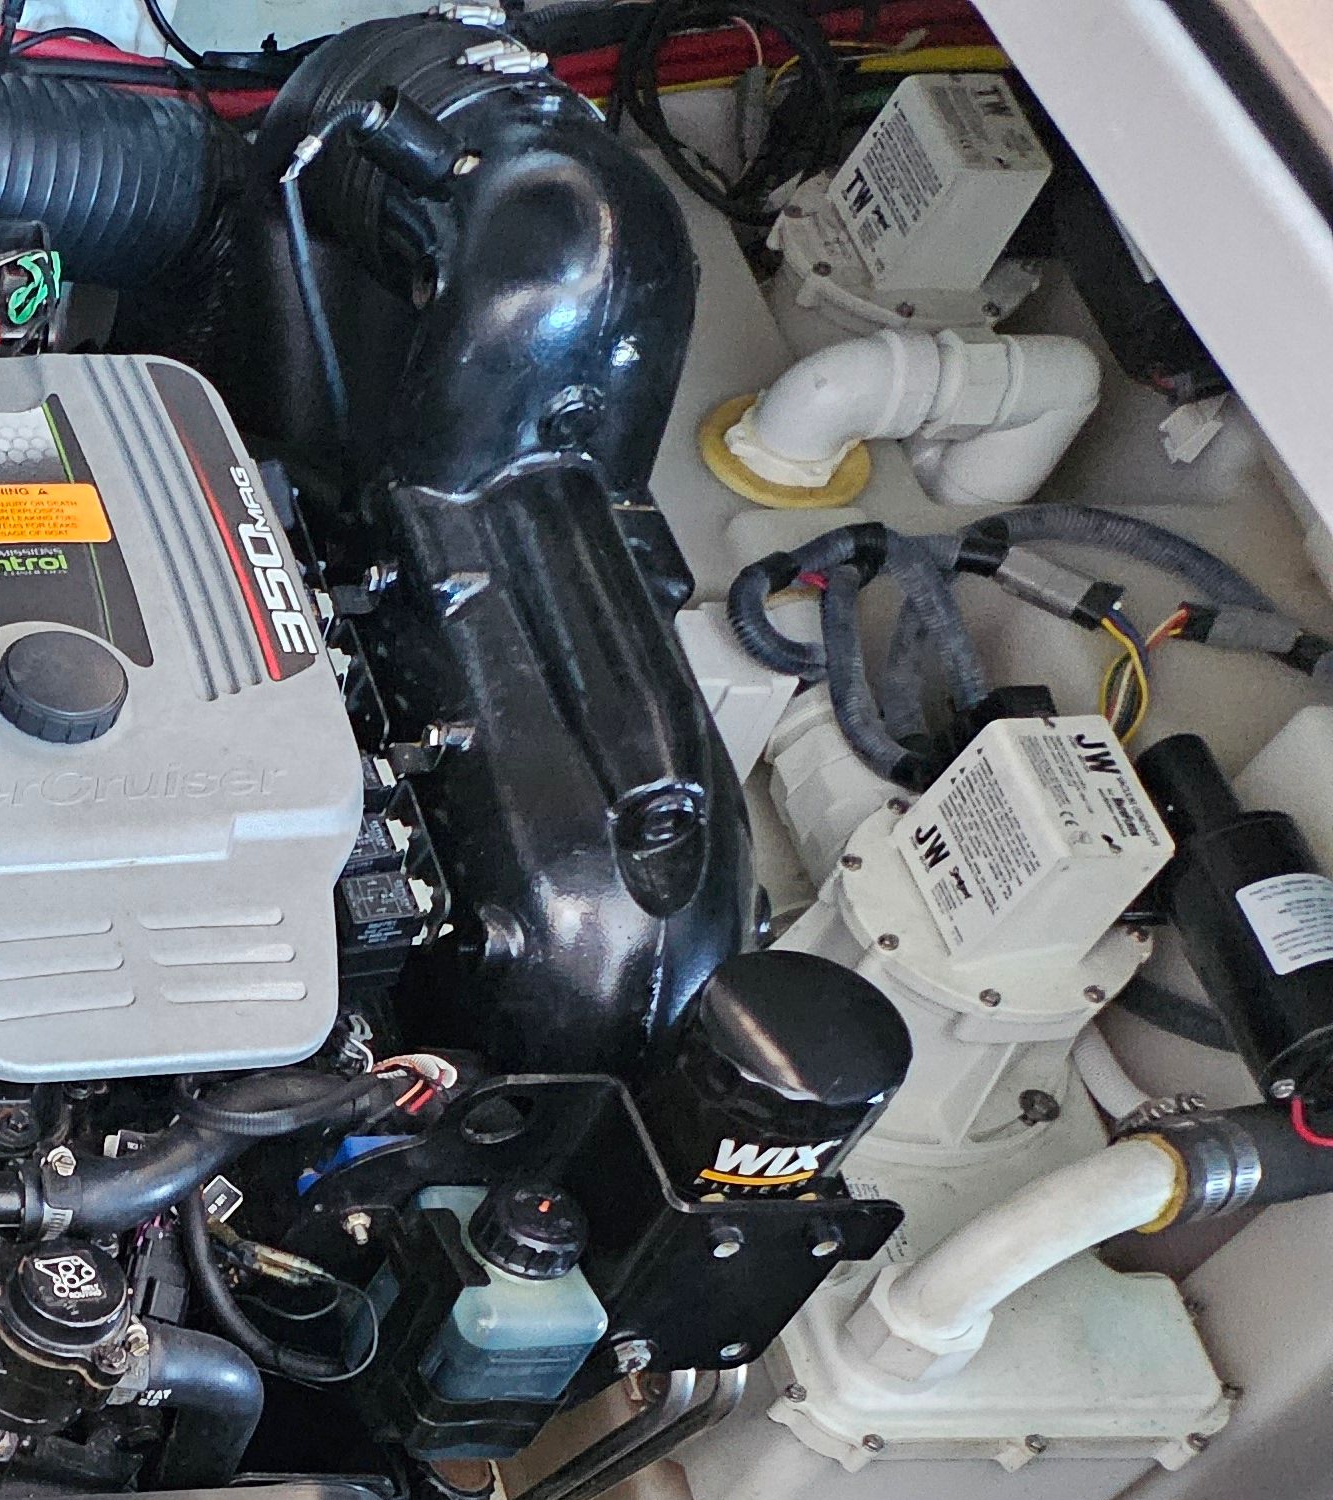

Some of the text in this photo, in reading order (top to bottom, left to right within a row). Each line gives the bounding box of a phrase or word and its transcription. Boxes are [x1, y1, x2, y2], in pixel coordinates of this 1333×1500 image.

[841, 165, 875, 220] TW
[229, 466, 318, 655] 350 MAG
[1074, 732, 1122, 775] JW
[914, 823, 951, 870] JW
[714, 1138, 841, 1177] WIX
